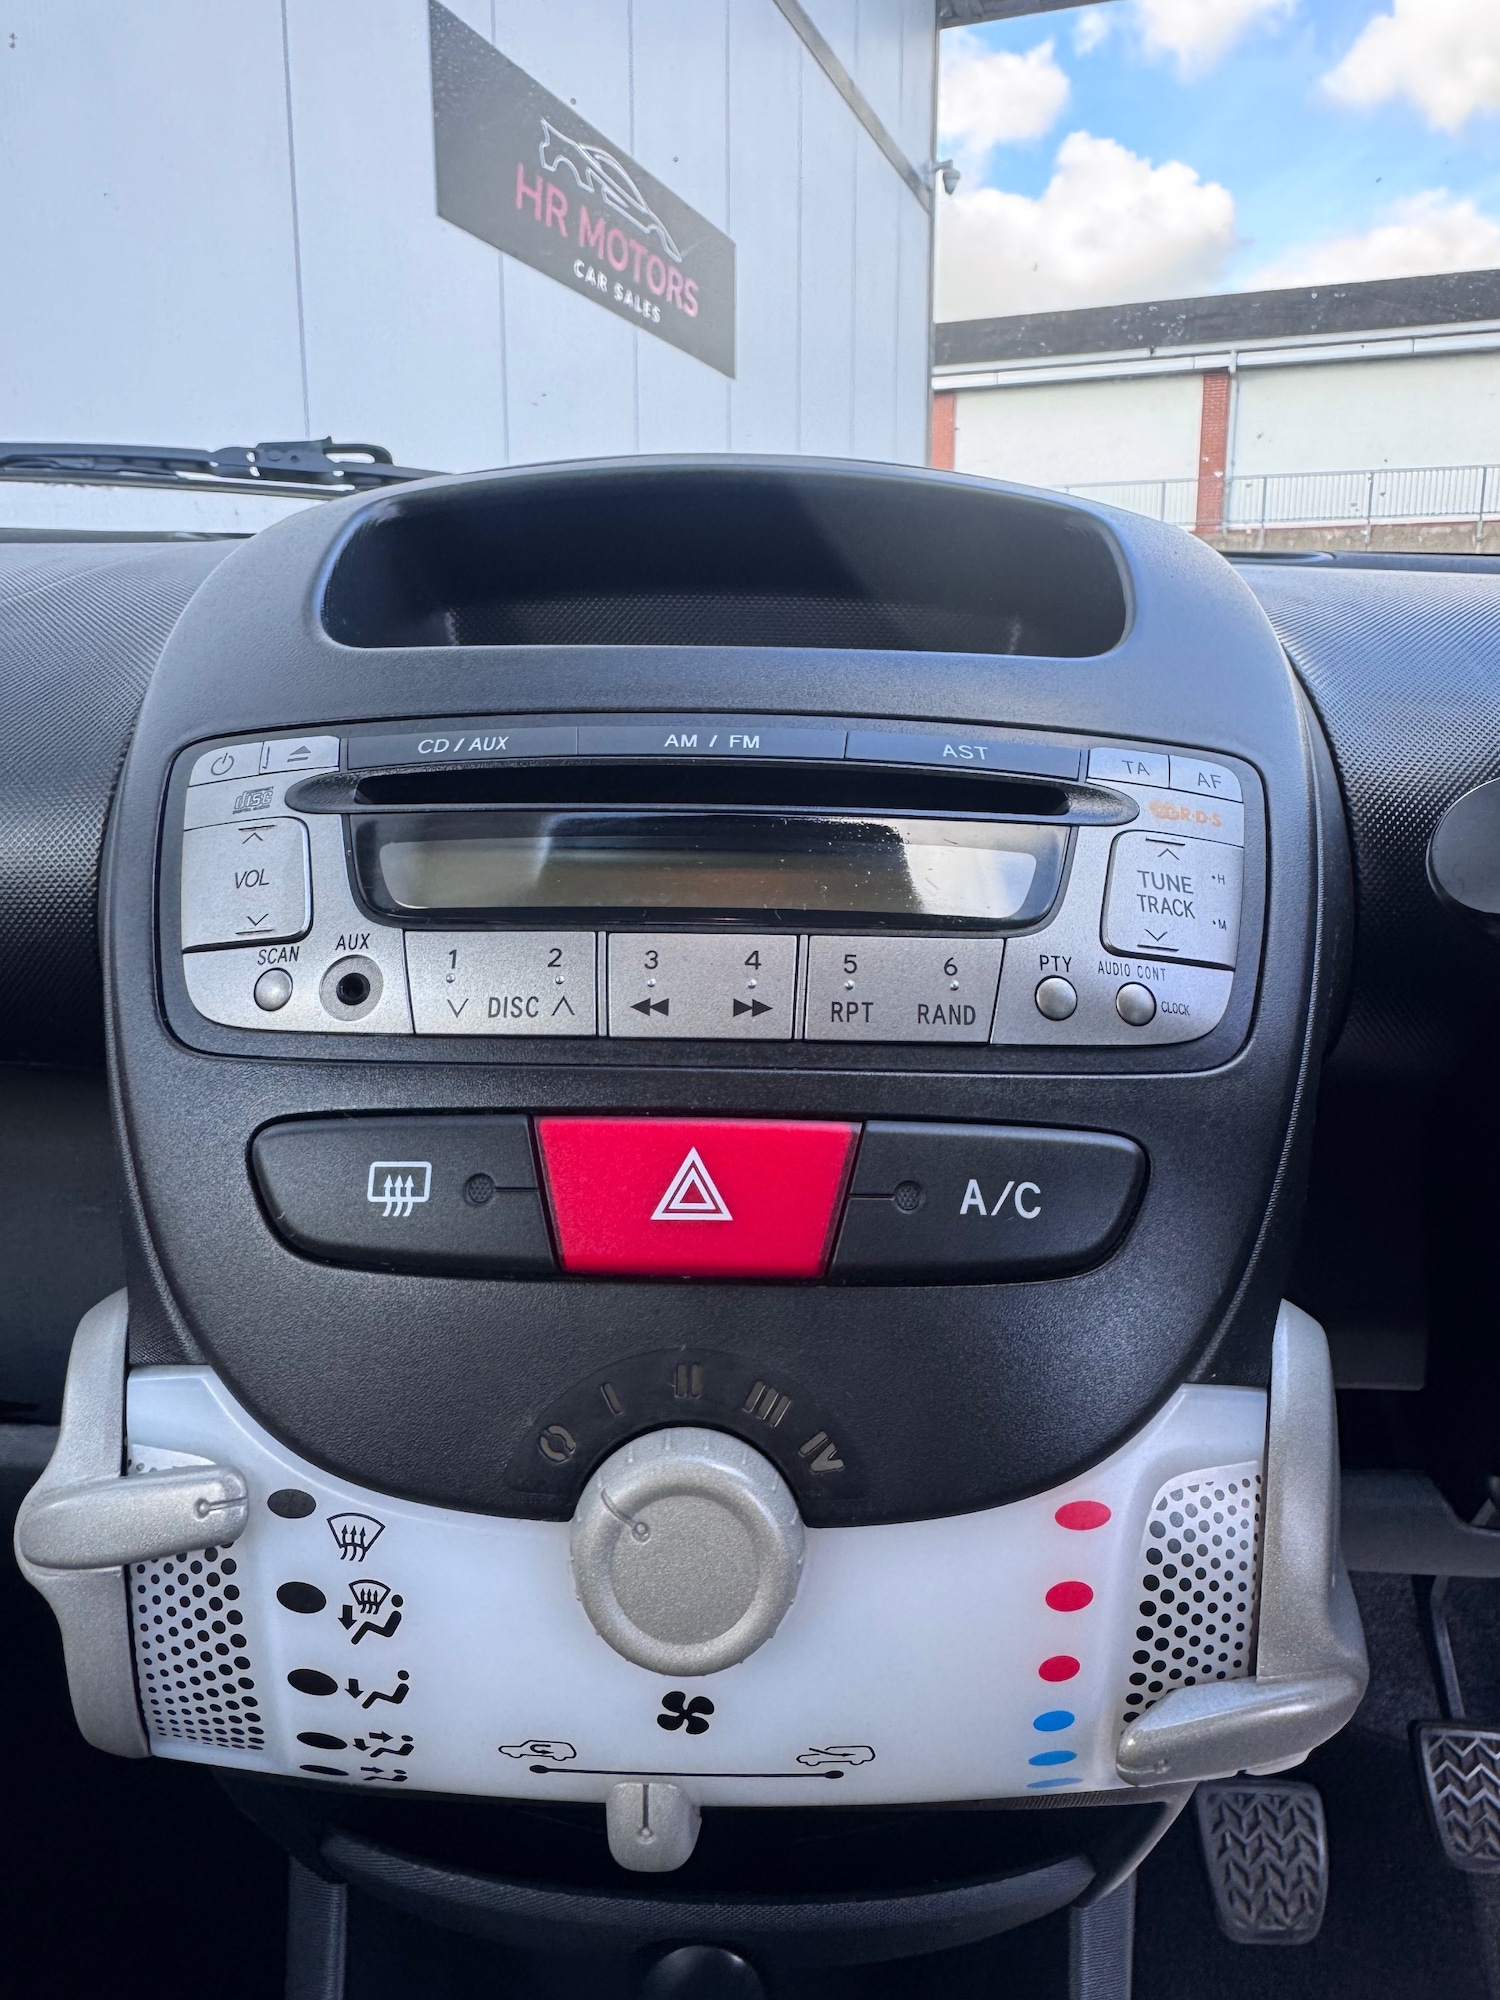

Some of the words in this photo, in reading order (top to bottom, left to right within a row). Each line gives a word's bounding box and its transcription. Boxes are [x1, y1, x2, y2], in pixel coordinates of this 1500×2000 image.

[515, 162, 568, 237] HR
[579, 206, 699, 317] MOTORS
[573, 259, 608, 292] CAR
[614, 283, 661, 323] SALES
[942, 744, 989, 761] AST
[1122, 760, 1150, 776] TA
[1197, 772, 1222, 788] AF
[234, 869, 270, 889] VOL
[1136, 870, 1194, 895] TUNE
[1136, 893, 1196, 919] TRACK
[335, 933, 371, 951] AUX
[256, 946, 299, 966] SCAN
[448, 950, 458, 969] 1
[547, 948, 562, 968] 2
[644, 950, 659, 970] 3
[744, 951, 762, 970] 4
[843, 954, 858, 974] 5
[1039, 954, 1072, 973] PTY
[943, 957, 958, 977] 6
[1097, 960, 1131, 978] AUDIO
[1137, 964, 1166, 981] CONT
[487, 996, 539, 1019] DISC
[831, 1001, 874, 1023] RPT
[917, 1004, 977, 1026] RAND
[1161, 1001, 1190, 1016] CLOCK
[959, 1178, 1042, 1219] A/C
